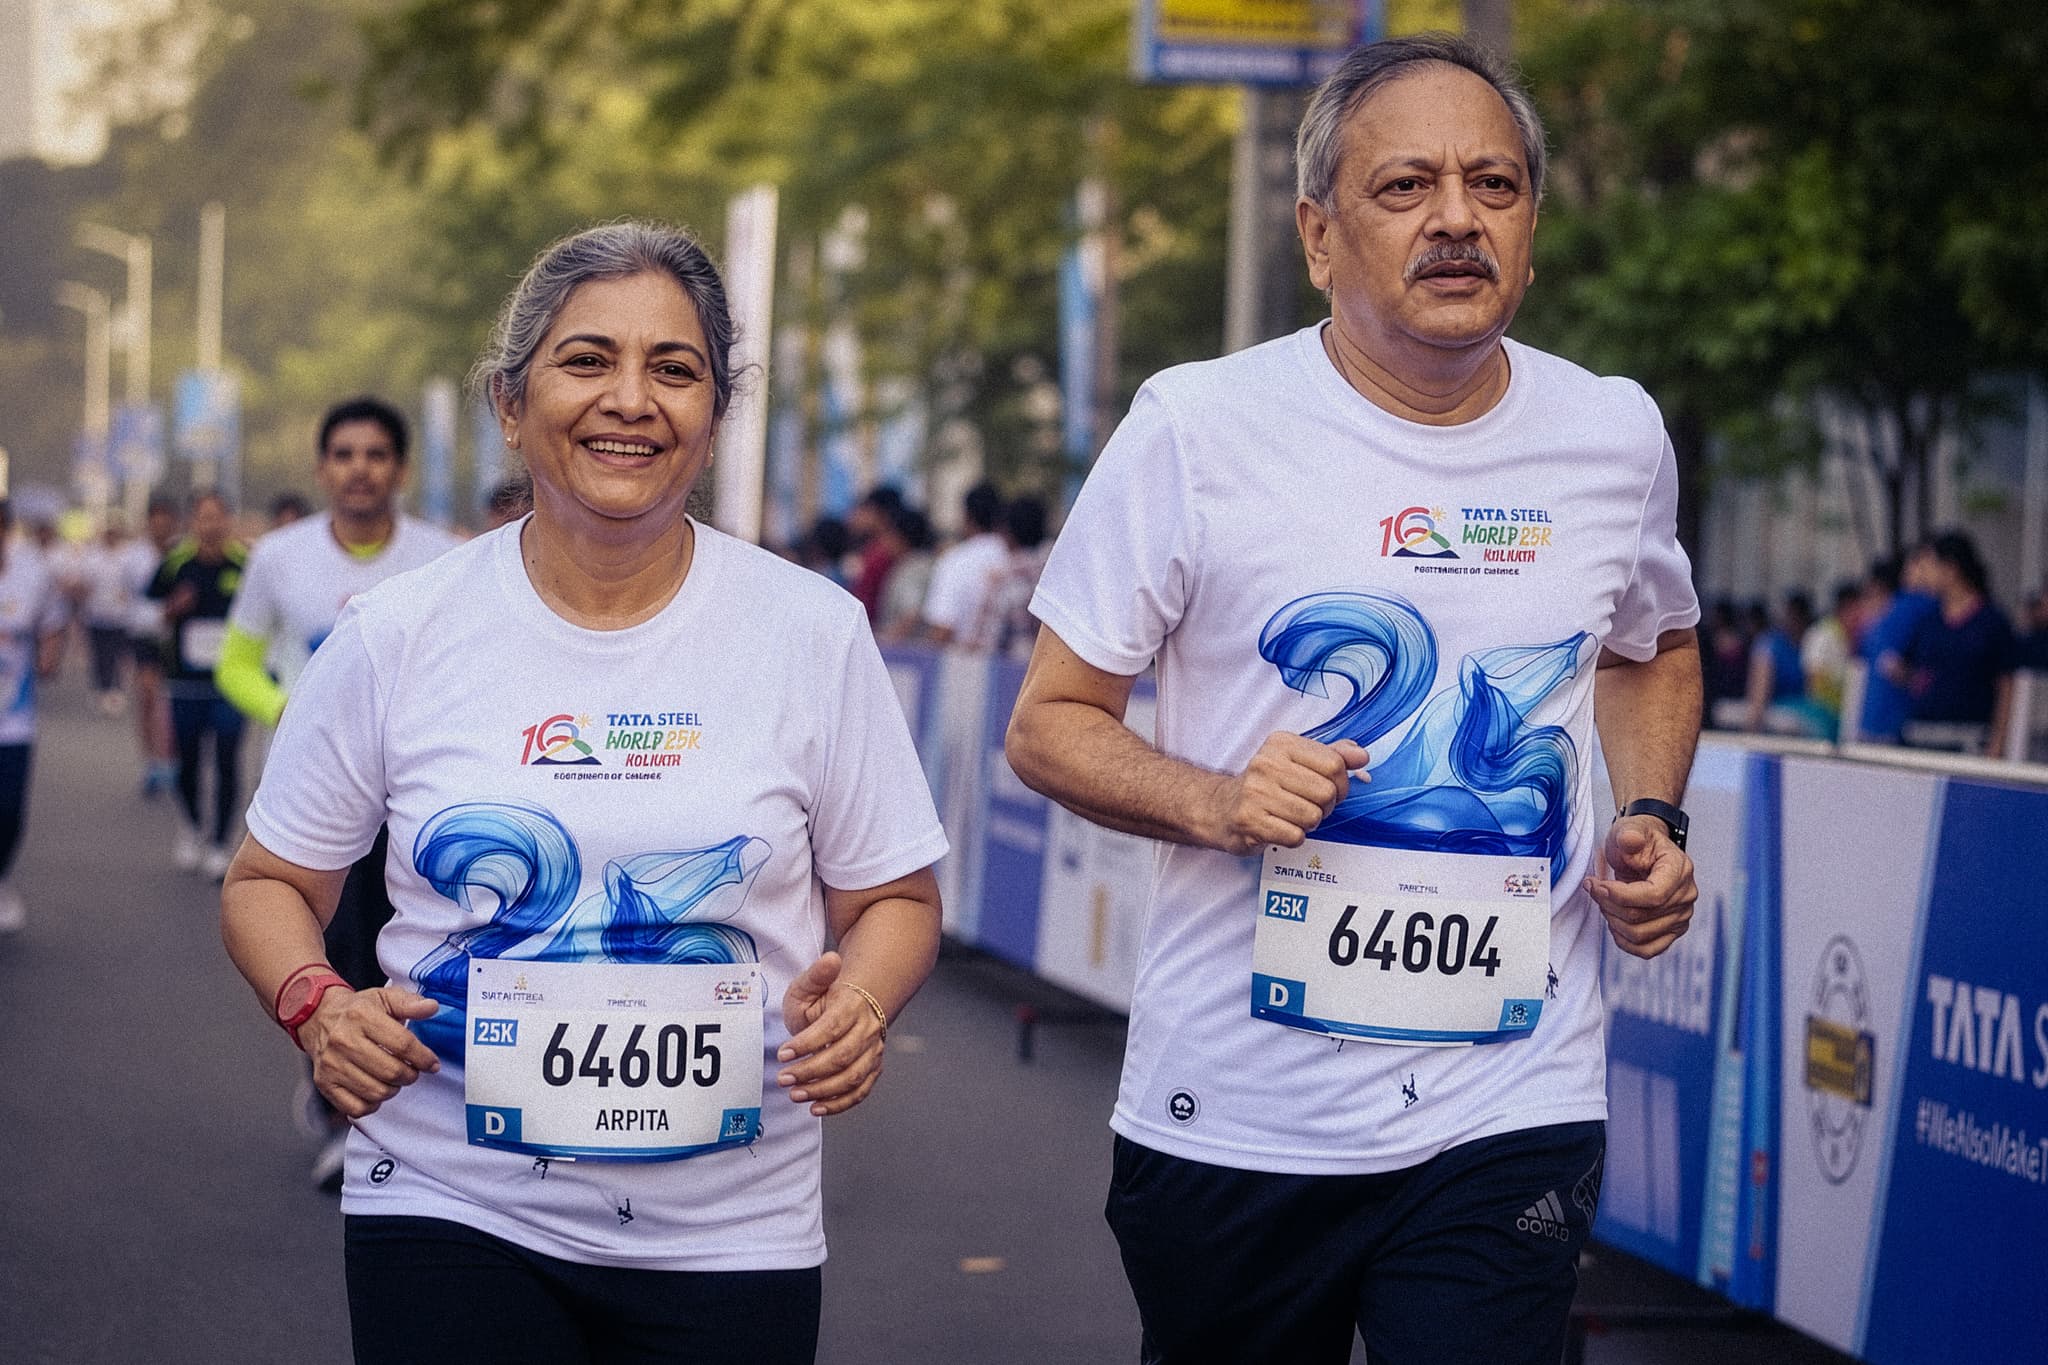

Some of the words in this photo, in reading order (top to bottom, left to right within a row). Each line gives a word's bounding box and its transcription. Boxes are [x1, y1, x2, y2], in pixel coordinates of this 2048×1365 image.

[1461, 508, 1508, 521] TATA
[1510, 508, 1552, 523] STEEL
[606, 713, 654, 727] TATA
[657, 712, 702, 727] STEEL
[1267, 894, 1305, 919] 25K
[1328, 904, 1501, 977] 64604
[1269, 982, 1289, 1008] D
[477, 1021, 514, 1044] 25K
[1927, 974, 2025, 1083] TATA
[542, 1022, 722, 1088] 64605
[484, 1111, 506, 1135] D
[595, 1109, 670, 1131] ARPITA
